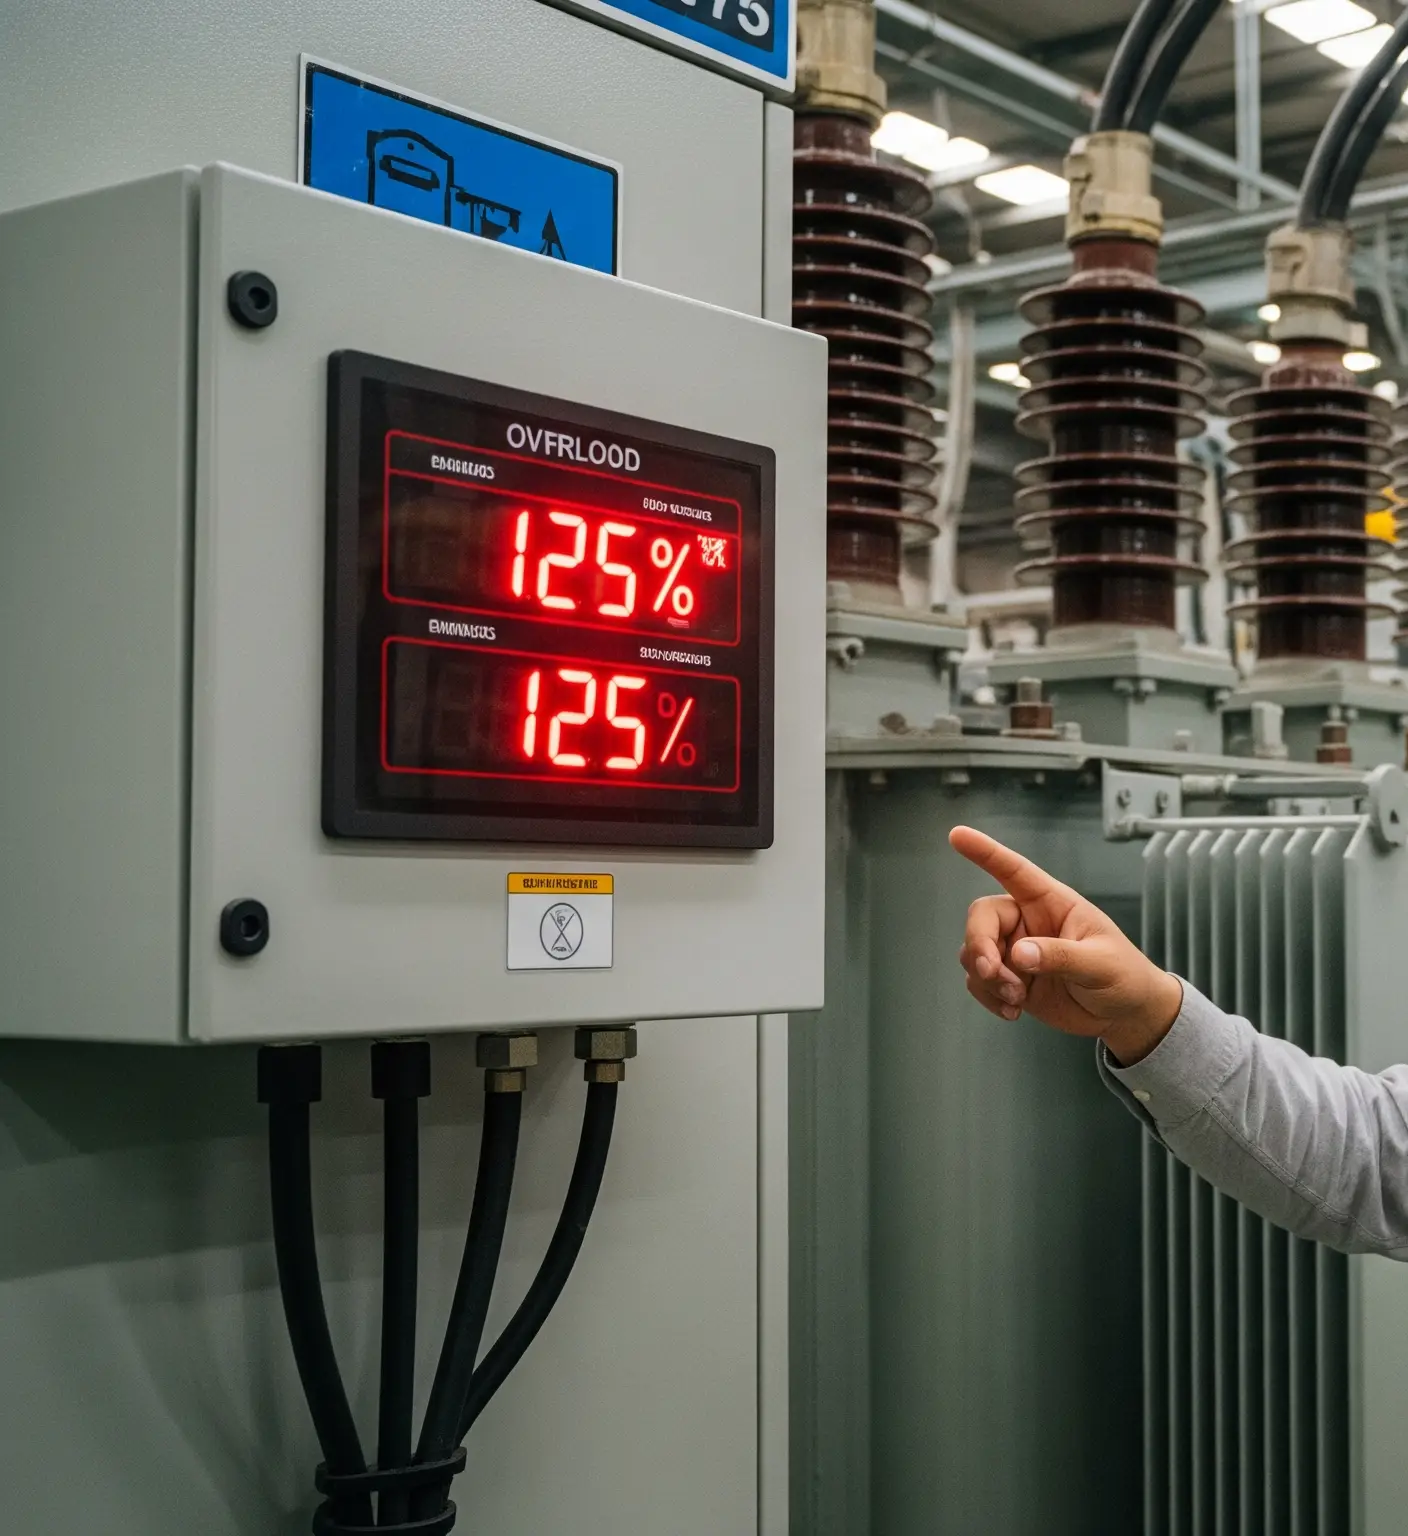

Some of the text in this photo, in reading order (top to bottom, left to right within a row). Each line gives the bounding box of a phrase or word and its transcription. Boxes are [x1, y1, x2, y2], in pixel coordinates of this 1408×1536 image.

[507, 423, 641, 472] OVFRLOOD
[511, 509, 695, 618] 125%
[521, 670, 697, 771] 125%
